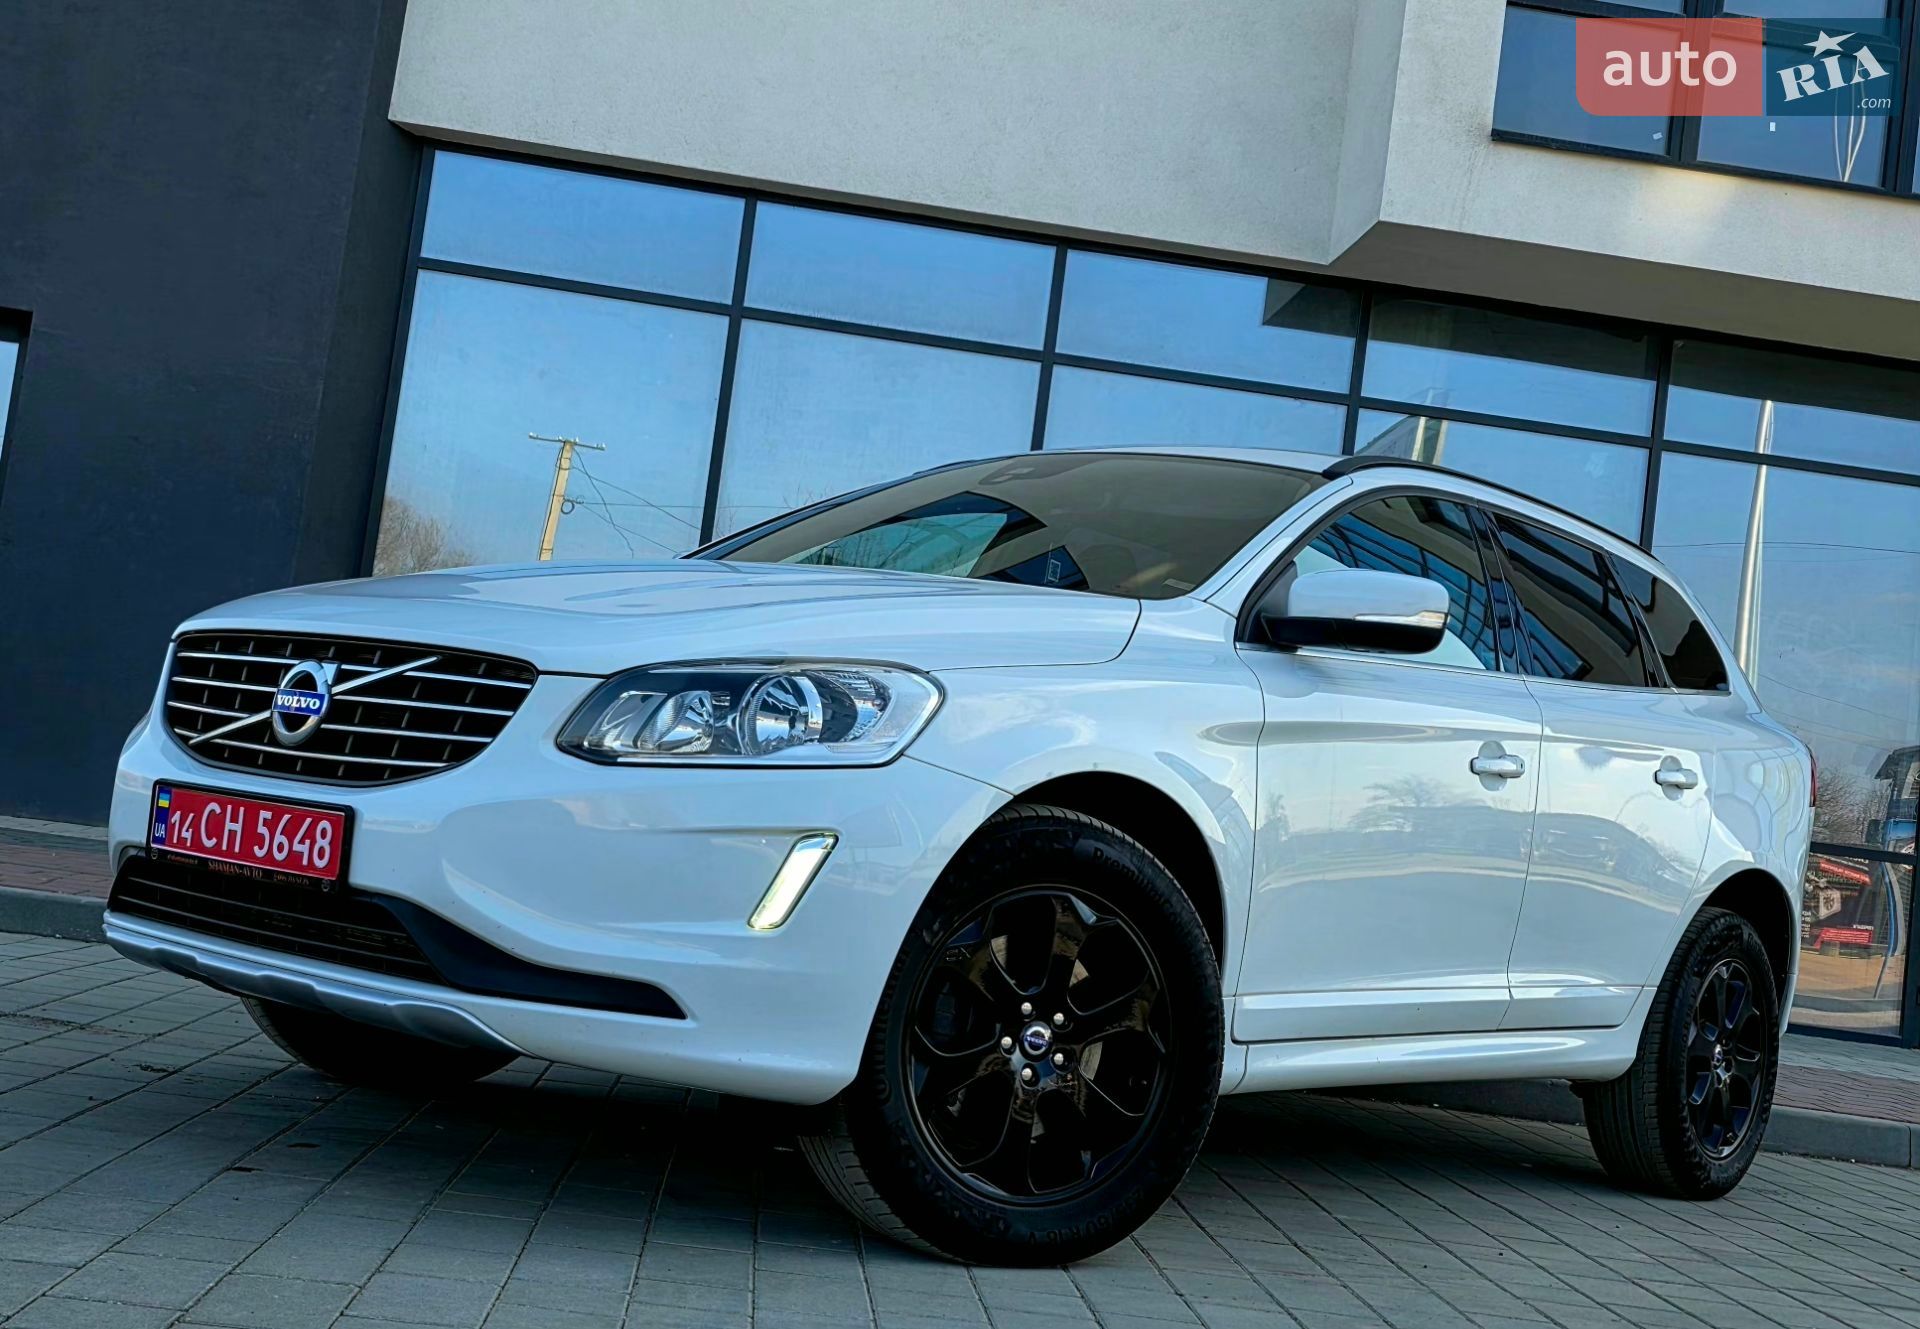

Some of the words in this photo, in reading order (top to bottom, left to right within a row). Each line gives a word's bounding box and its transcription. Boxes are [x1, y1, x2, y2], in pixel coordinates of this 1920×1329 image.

[277, 694, 320, 710] VOLVO
[154, 822, 166, 839] UA
[253, 810, 333, 869] 5648
